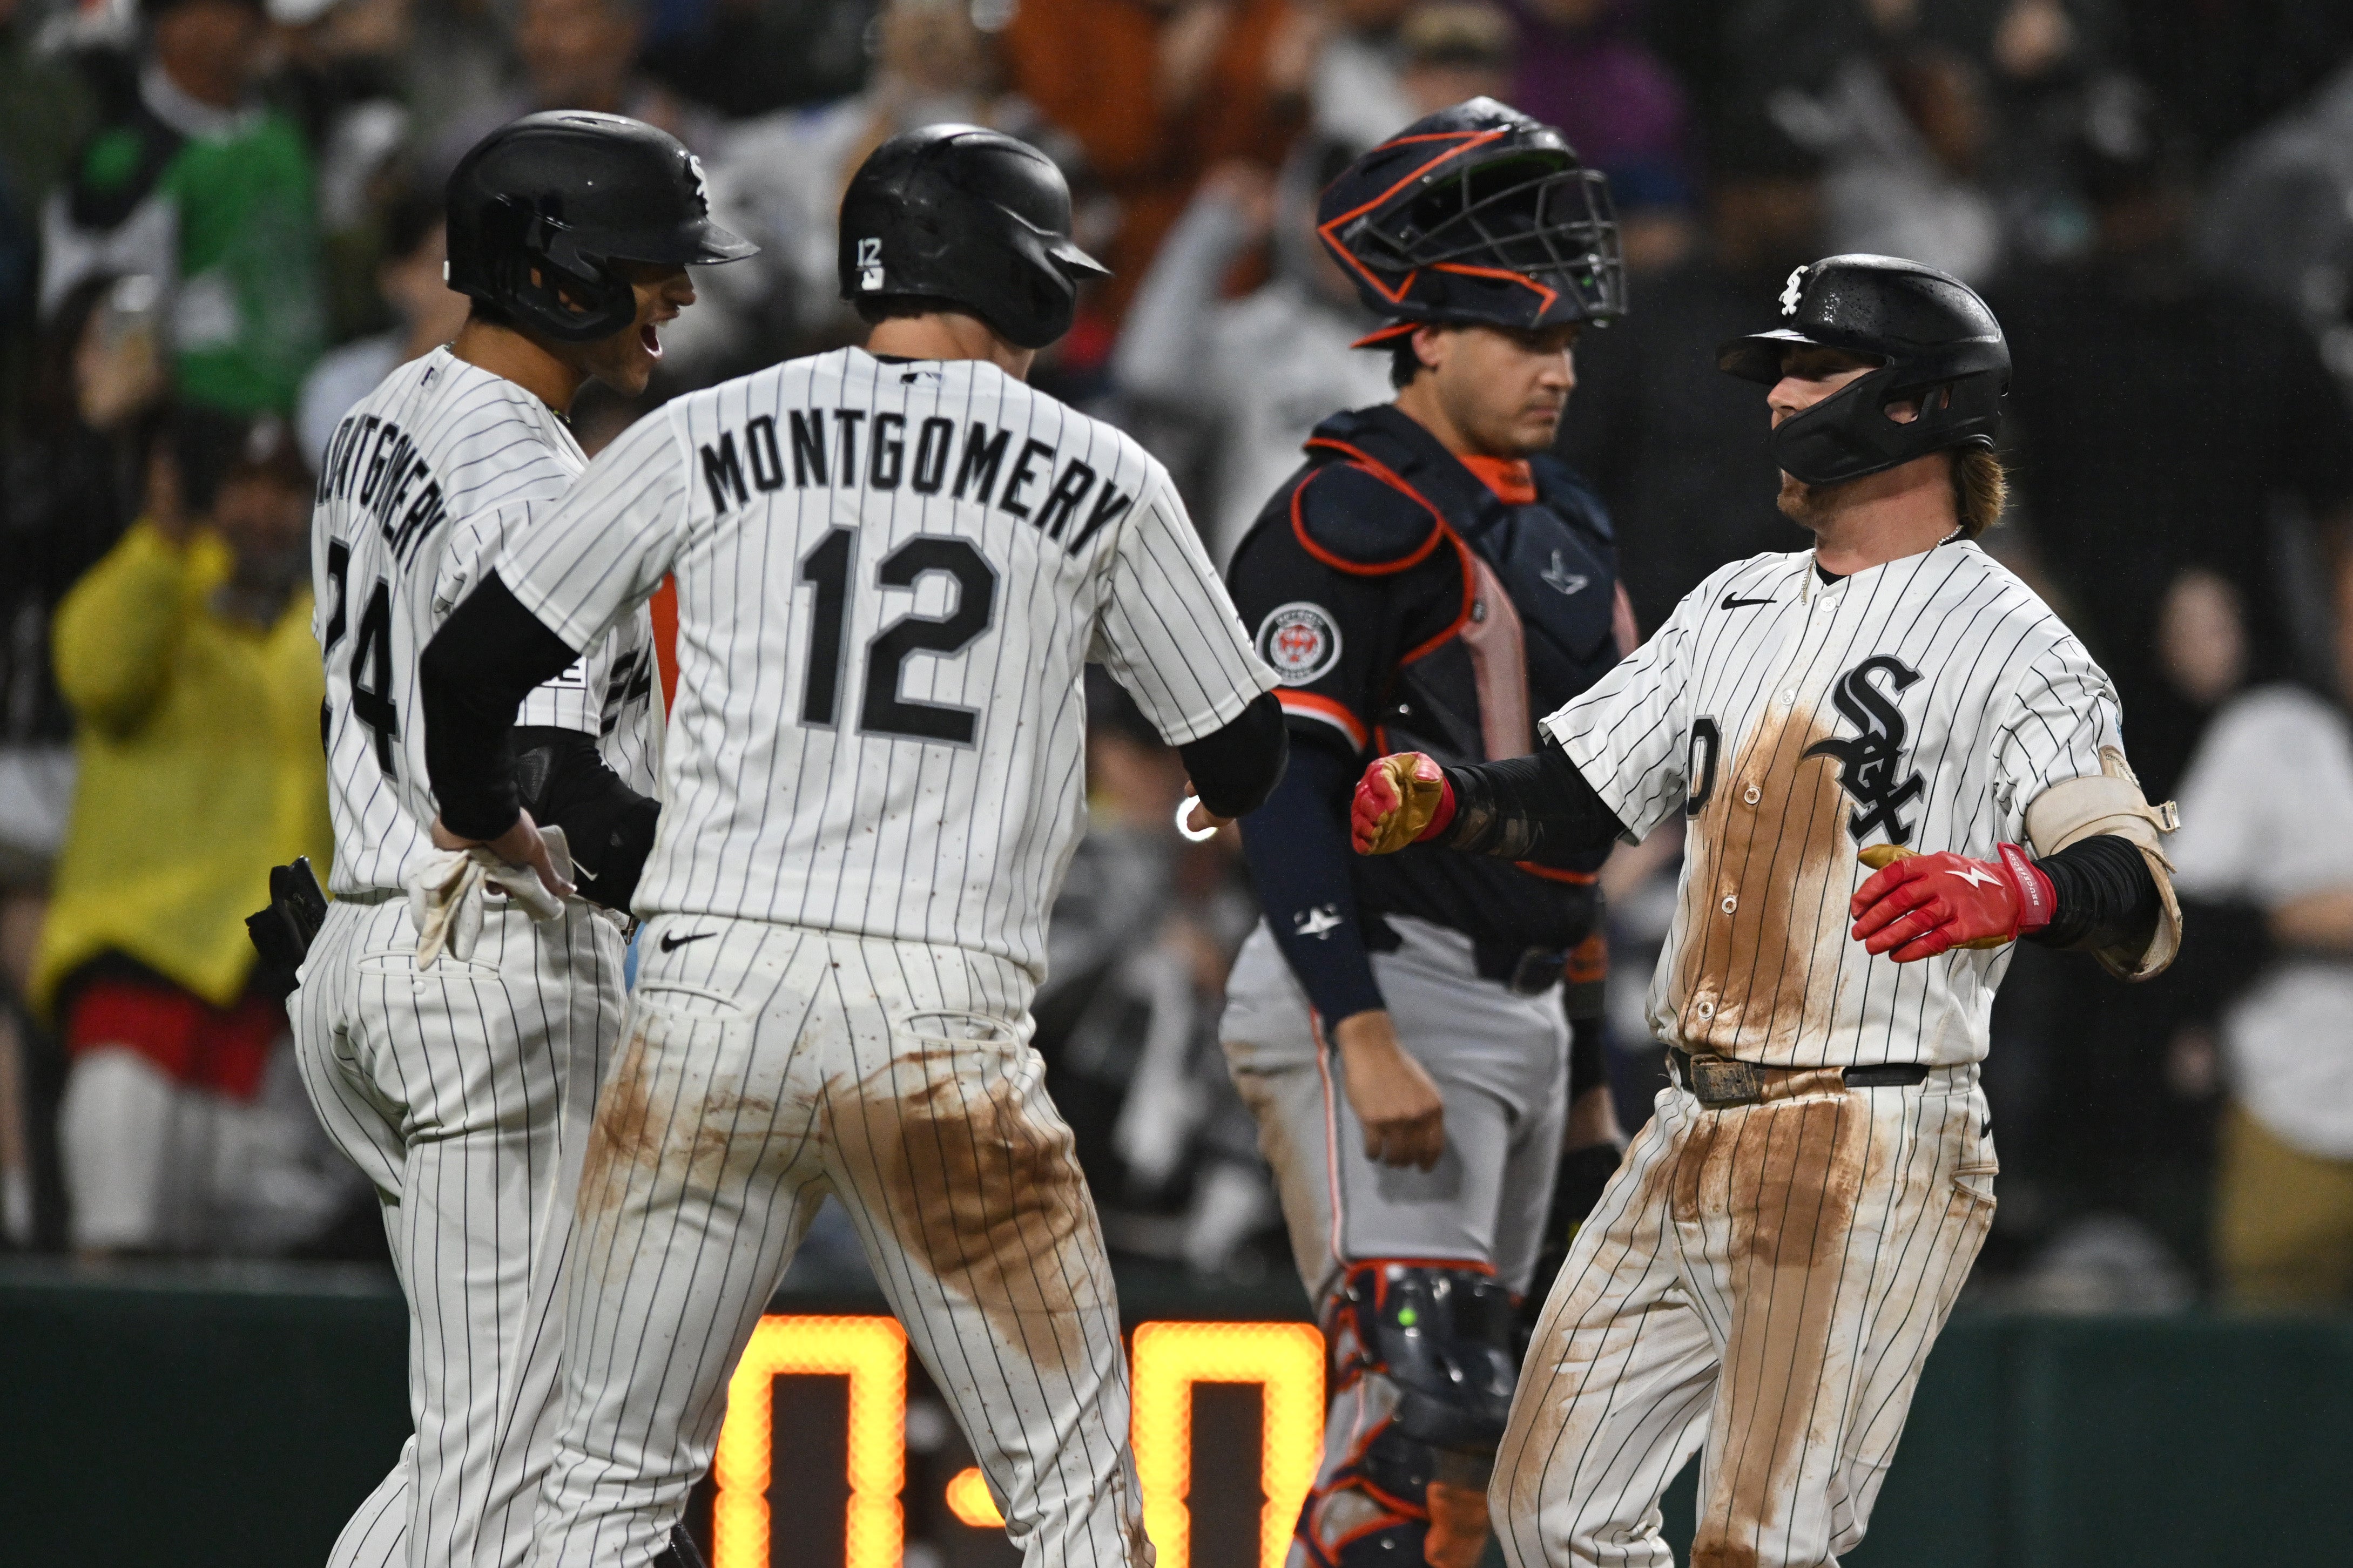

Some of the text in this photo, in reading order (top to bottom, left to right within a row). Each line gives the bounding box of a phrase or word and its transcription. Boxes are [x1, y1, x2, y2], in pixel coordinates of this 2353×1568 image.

[857, 237, 882, 268] 12
[699, 407, 1131, 558] MONTGOMERY
[795, 523, 1000, 752] 12
[1797, 653, 1927, 846] Sox
[2024, 875, 2039, 906] BRUCE
